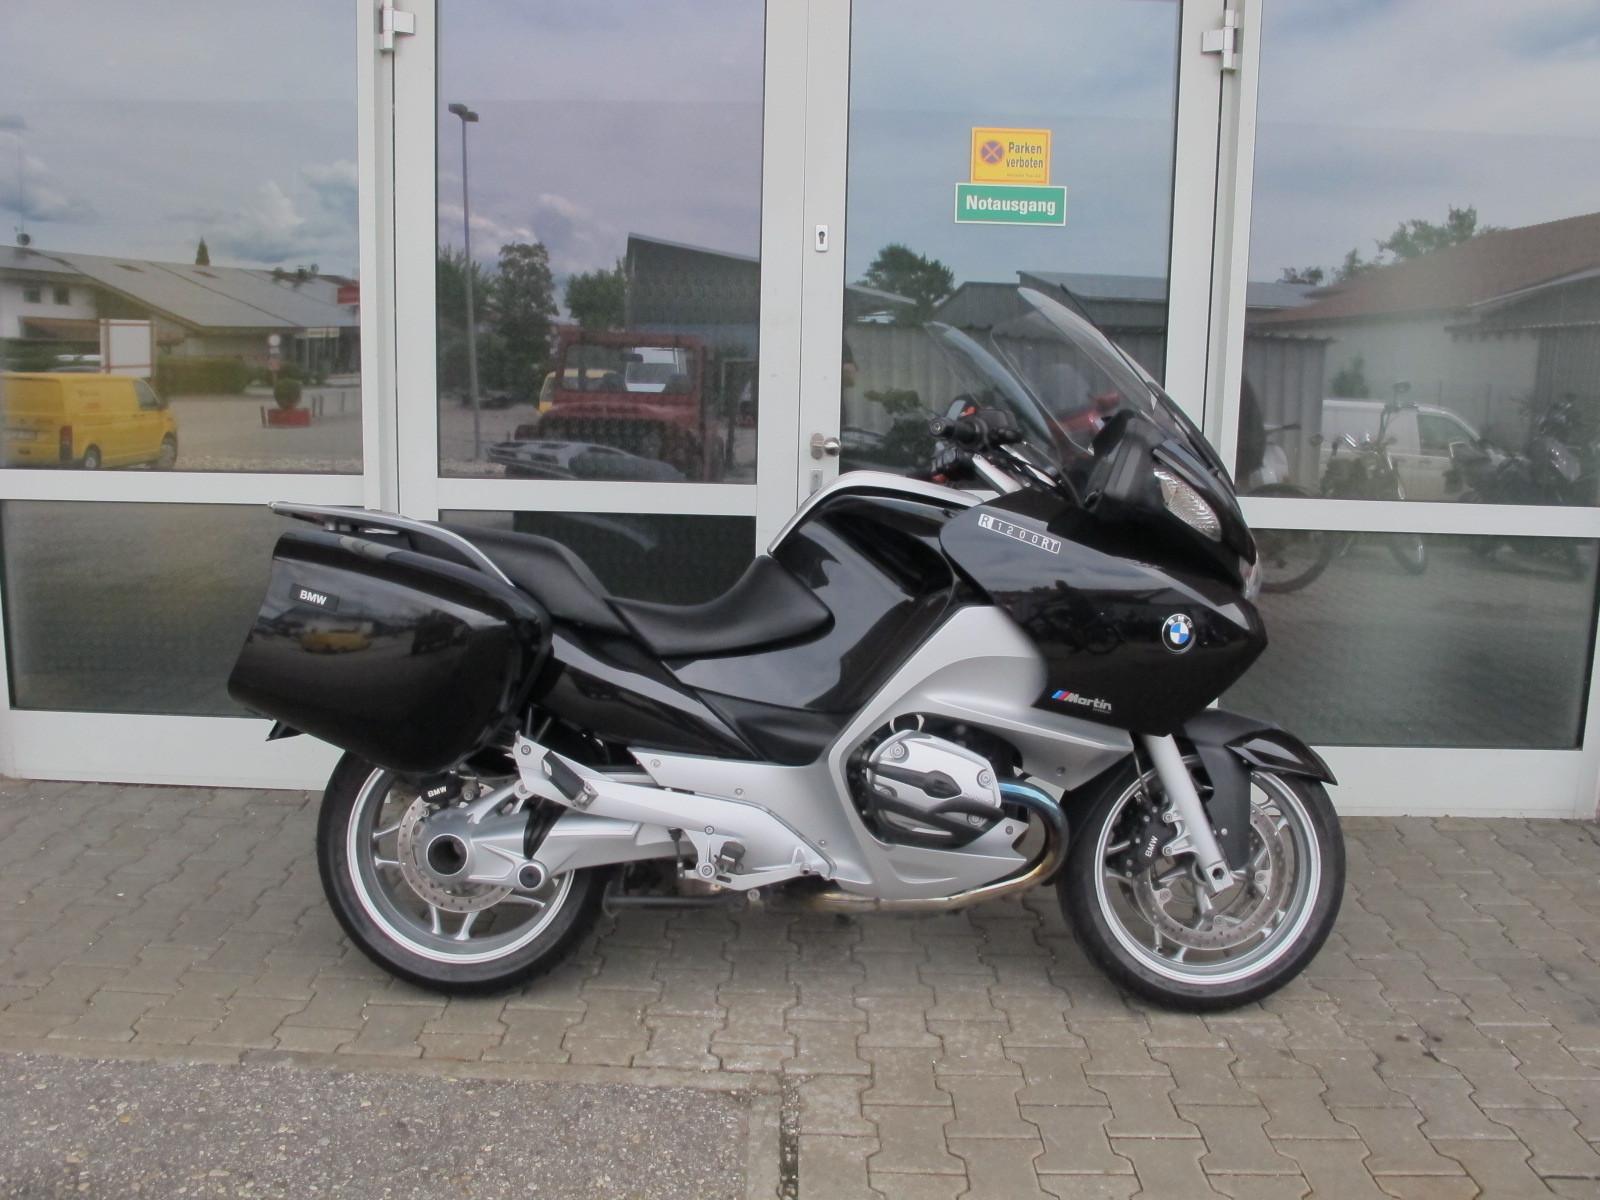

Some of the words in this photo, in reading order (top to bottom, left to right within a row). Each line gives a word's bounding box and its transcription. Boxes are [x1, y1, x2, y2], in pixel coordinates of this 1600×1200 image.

[1008, 141, 1042, 155] Parken
[1006, 156, 1043, 169] verboten
[966, 194, 1056, 216] Notausgang
[300, 589, 327, 606] BMW
[1068, 692, 1112, 711] Martin
[427, 785, 447, 798] BMW
[1144, 835, 1158, 858] BMW
